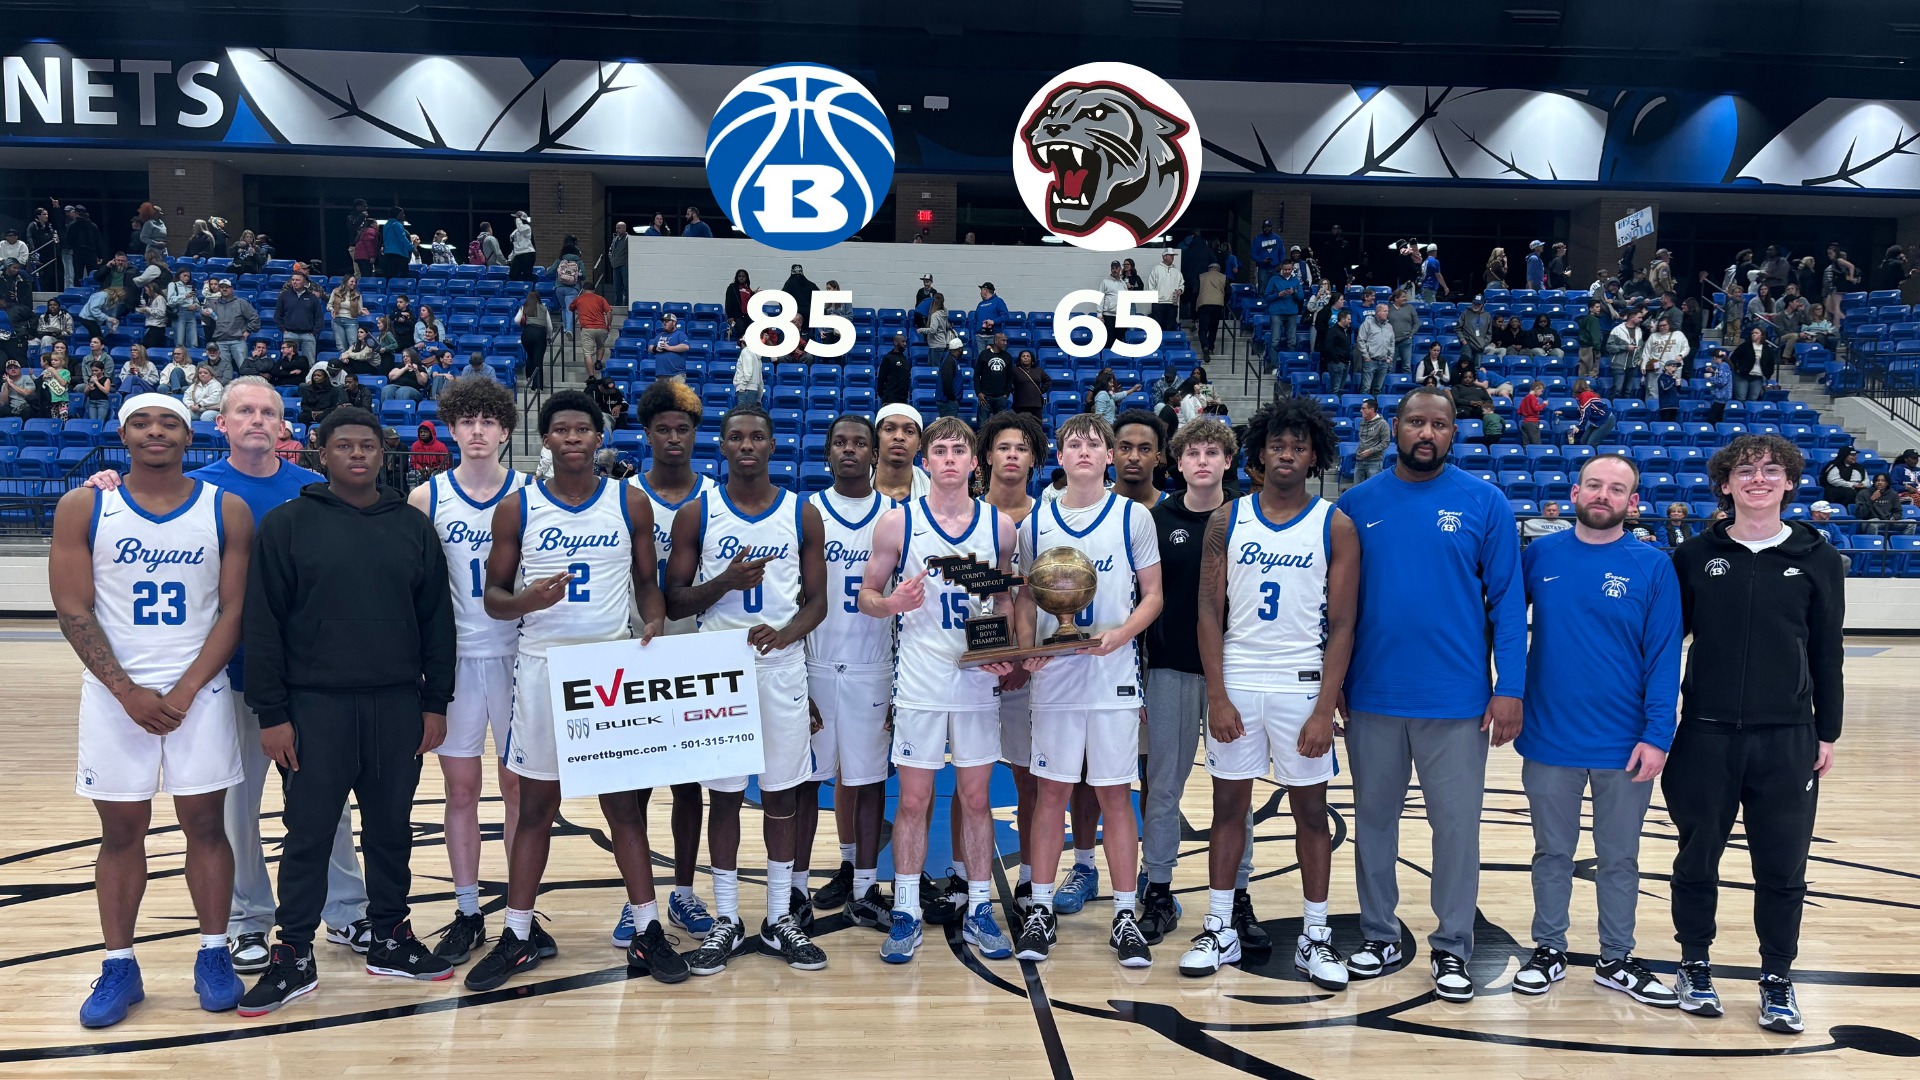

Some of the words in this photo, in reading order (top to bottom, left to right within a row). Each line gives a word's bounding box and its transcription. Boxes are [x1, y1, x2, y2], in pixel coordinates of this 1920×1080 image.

[3, 56, 224, 128] NETS
[112, 537, 205, 574] Bryant
[536, 527, 620, 556] Bryant
[1236, 541, 1314, 574] Bryant
[567, 562, 590, 602] 2
[950, 563, 973, 572] SALINE
[961, 571, 987, 580] COUNTY
[971, 578, 1005, 589] SHOOT-OUT
[1604, 572, 1630, 583] Bryant
[132, 580, 187, 626] 23
[843, 575, 863, 614] 5
[1257, 581, 1281, 621] 3
[940, 592, 970, 630] 15
[971, 636, 1006, 645] CHAMPION
[975, 623, 999, 632] SENIOR
[979, 630, 997, 638] BOYS
[562, 668, 745, 711] EVERETT
[595, 715, 663, 731] BUICK
[683, 704, 749, 723] GMC
[567, 743, 668, 764] everettbgmc.com
[680, 732, 755, 750] 501-315-7100
